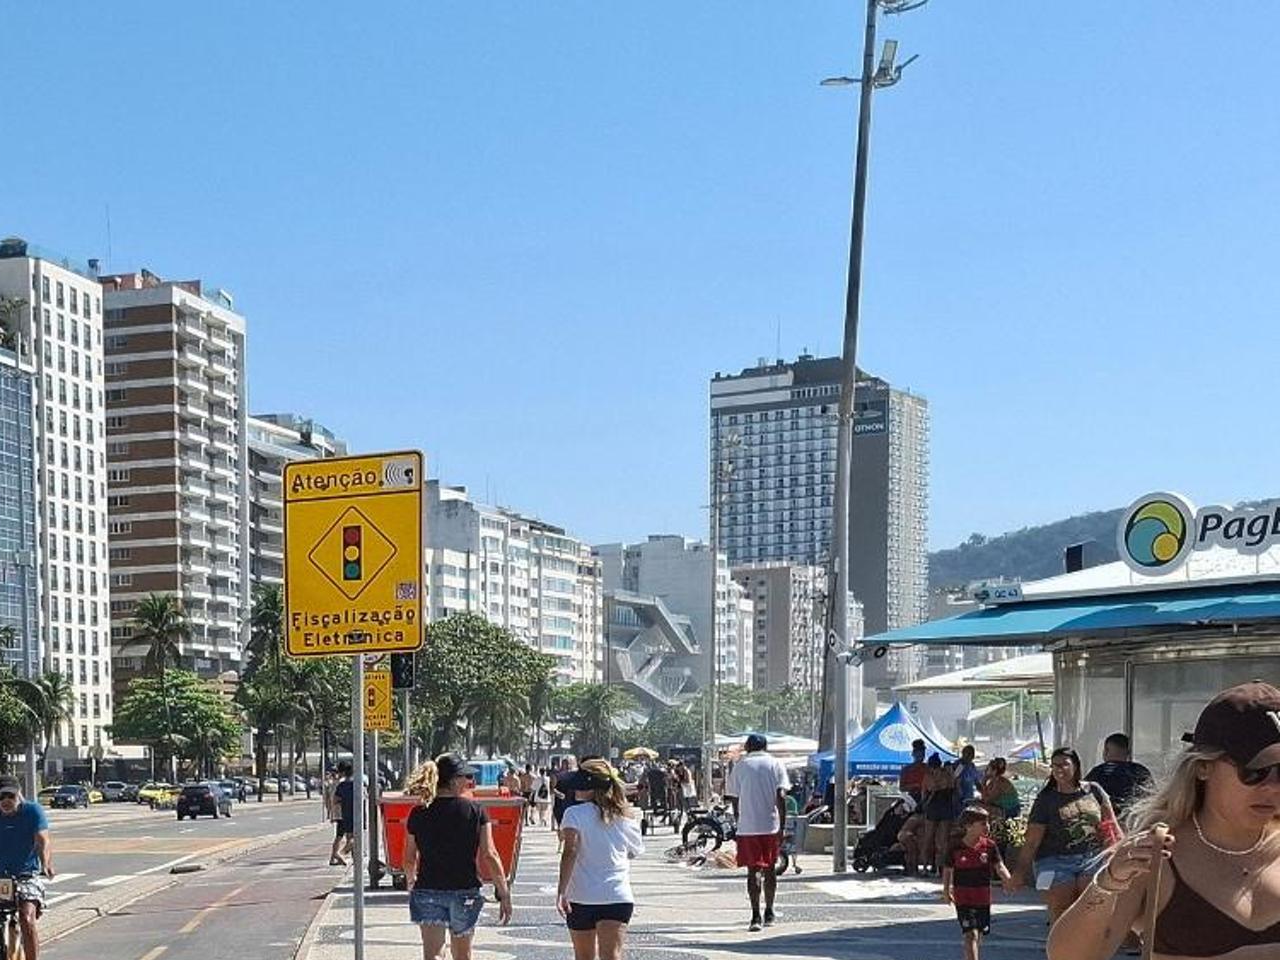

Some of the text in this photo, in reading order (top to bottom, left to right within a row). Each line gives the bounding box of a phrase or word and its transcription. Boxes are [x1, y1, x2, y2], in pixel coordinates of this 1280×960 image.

[291, 468, 377, 491] Atenção
[292, 605, 416, 627] Fiscalização
[304, 630, 404, 647] Eletrnica
